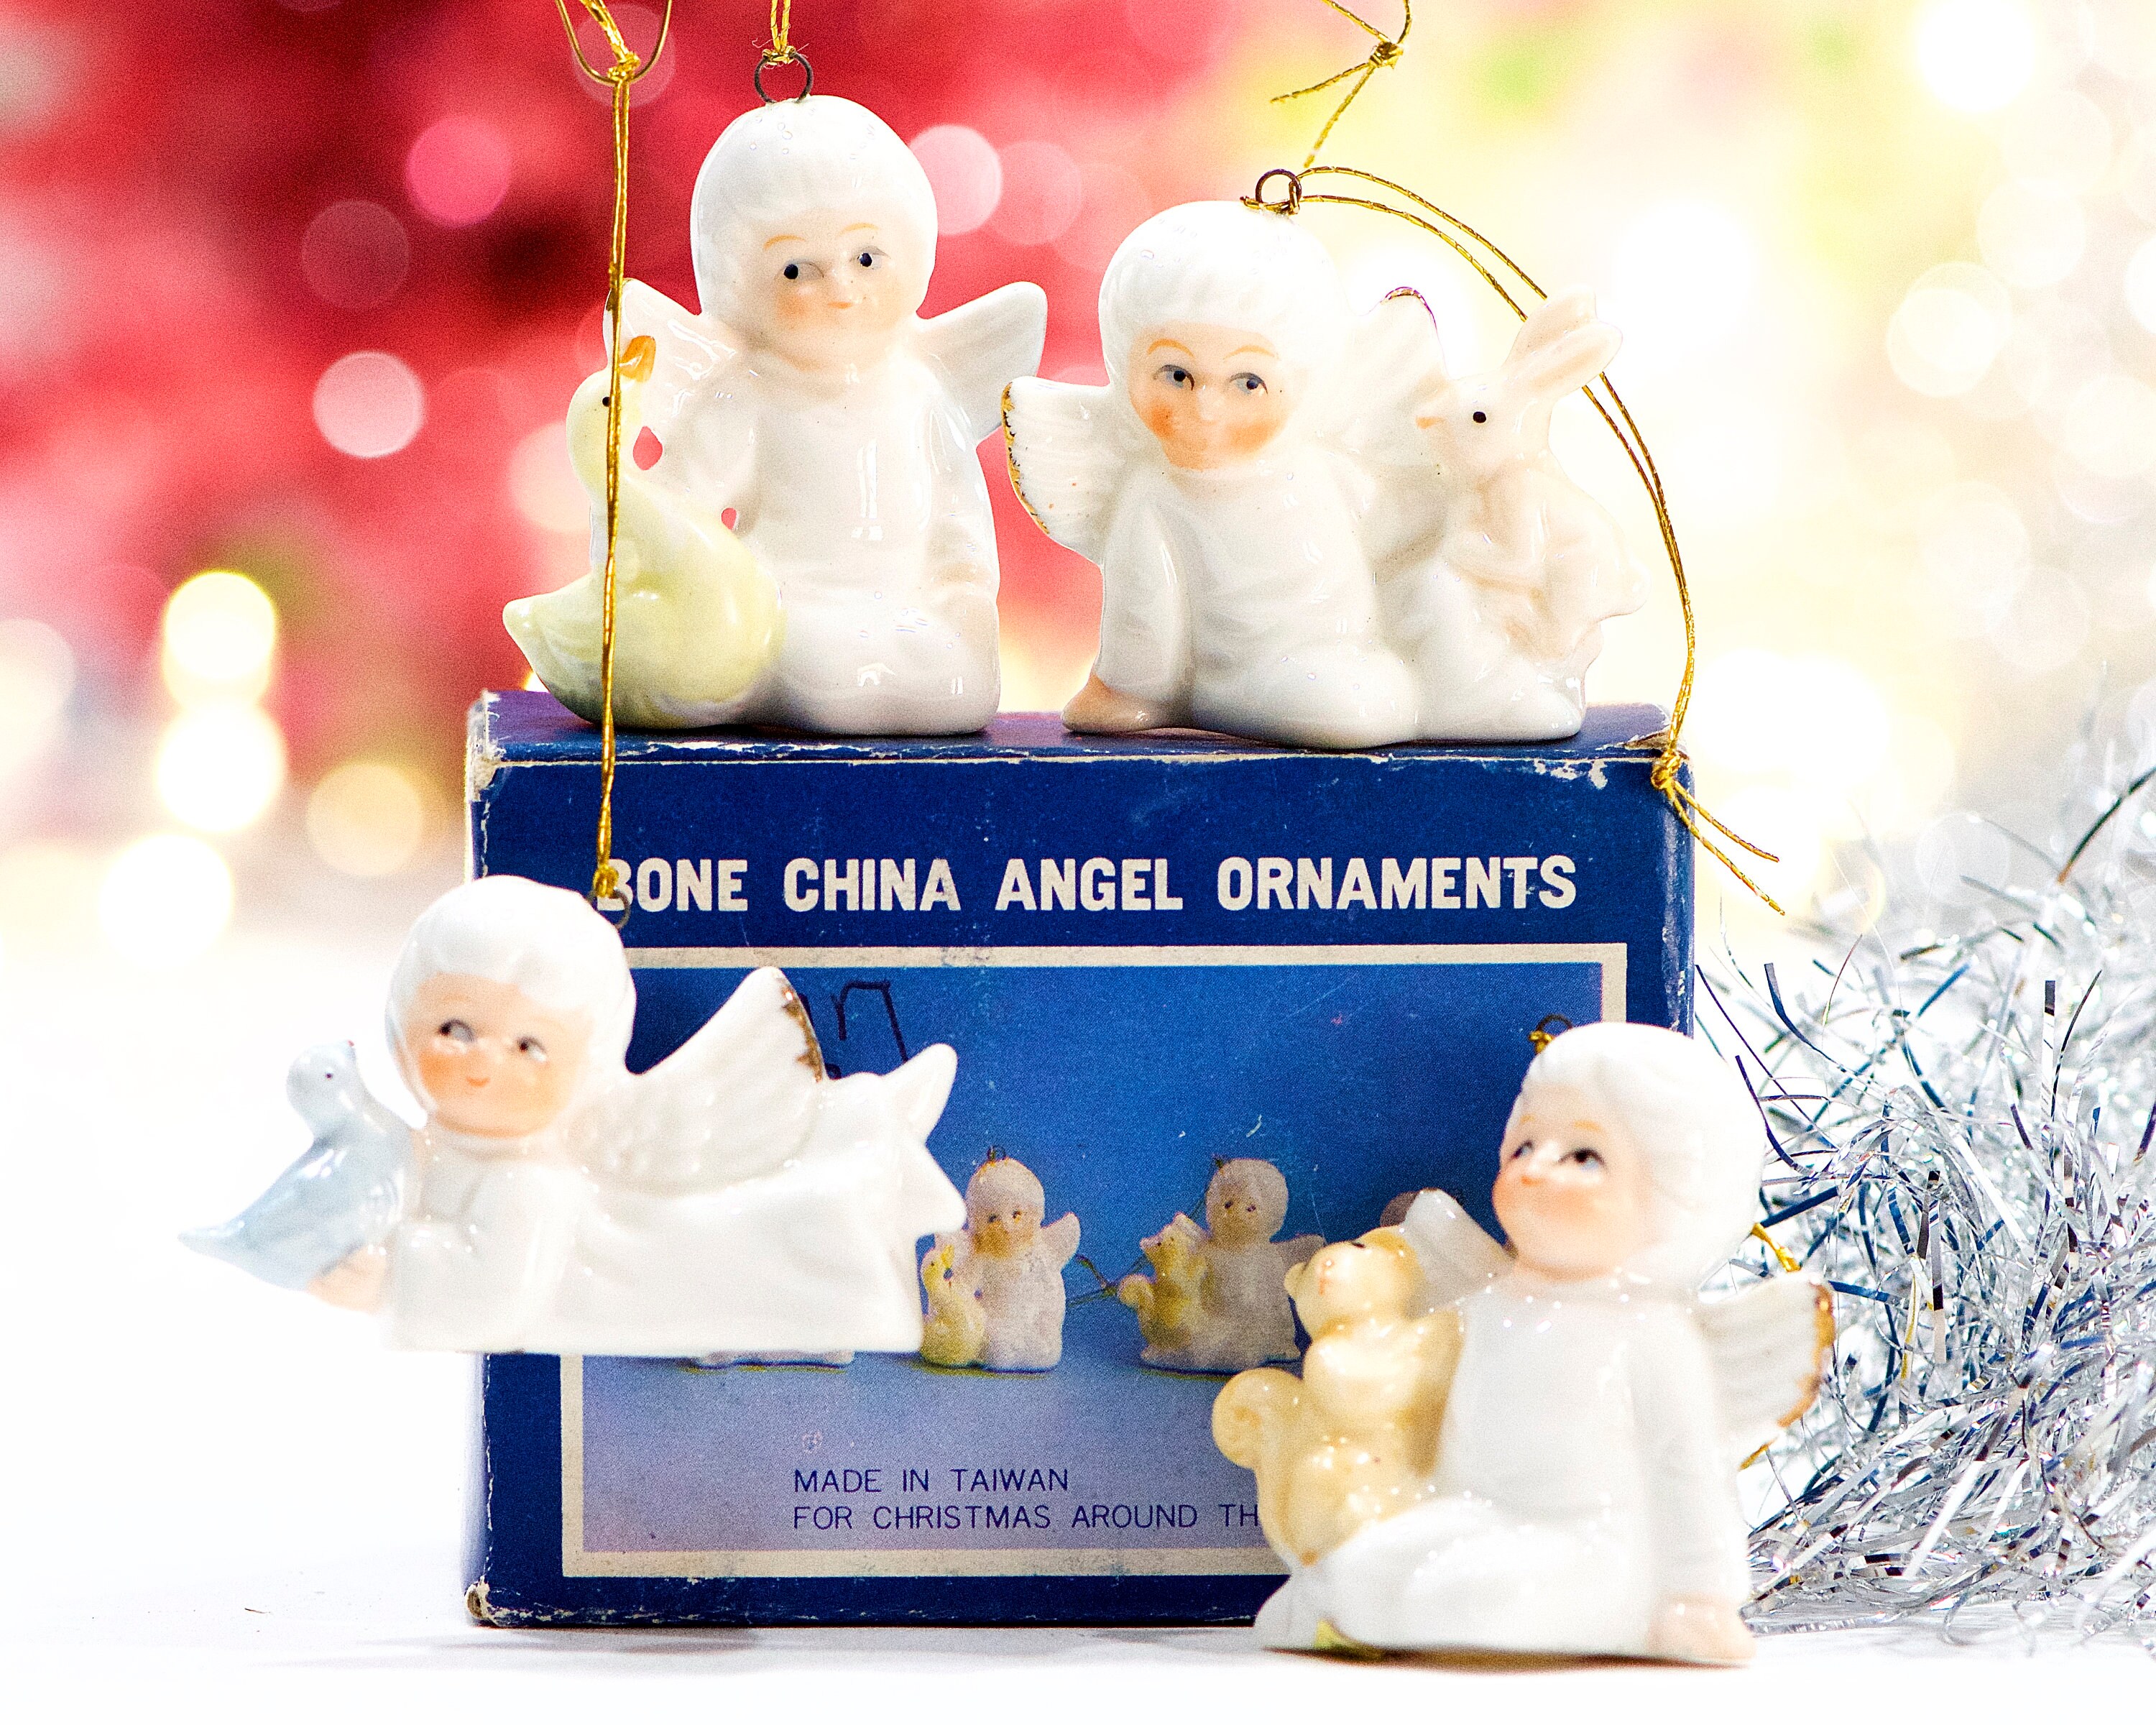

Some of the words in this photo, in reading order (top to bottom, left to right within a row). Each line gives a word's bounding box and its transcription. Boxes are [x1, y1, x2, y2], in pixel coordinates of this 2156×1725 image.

[596, 857, 747, 912] BONE
[784, 857, 961, 912] CHINA
[995, 857, 1184, 911] ANGEL
[1217, 855, 1576, 911] ORNAMENTS
[793, 1469, 882, 1494] MADE
[902, 1469, 929, 1492] IN
[950, 1468, 1069, 1492] TAIWAN
[793, 1506, 853, 1530] FOR
[872, 1505, 1051, 1530] CHRISTMAS
[1071, 1504, 1199, 1529] AROUND
[1217, 1503, 1258, 1527] TH
